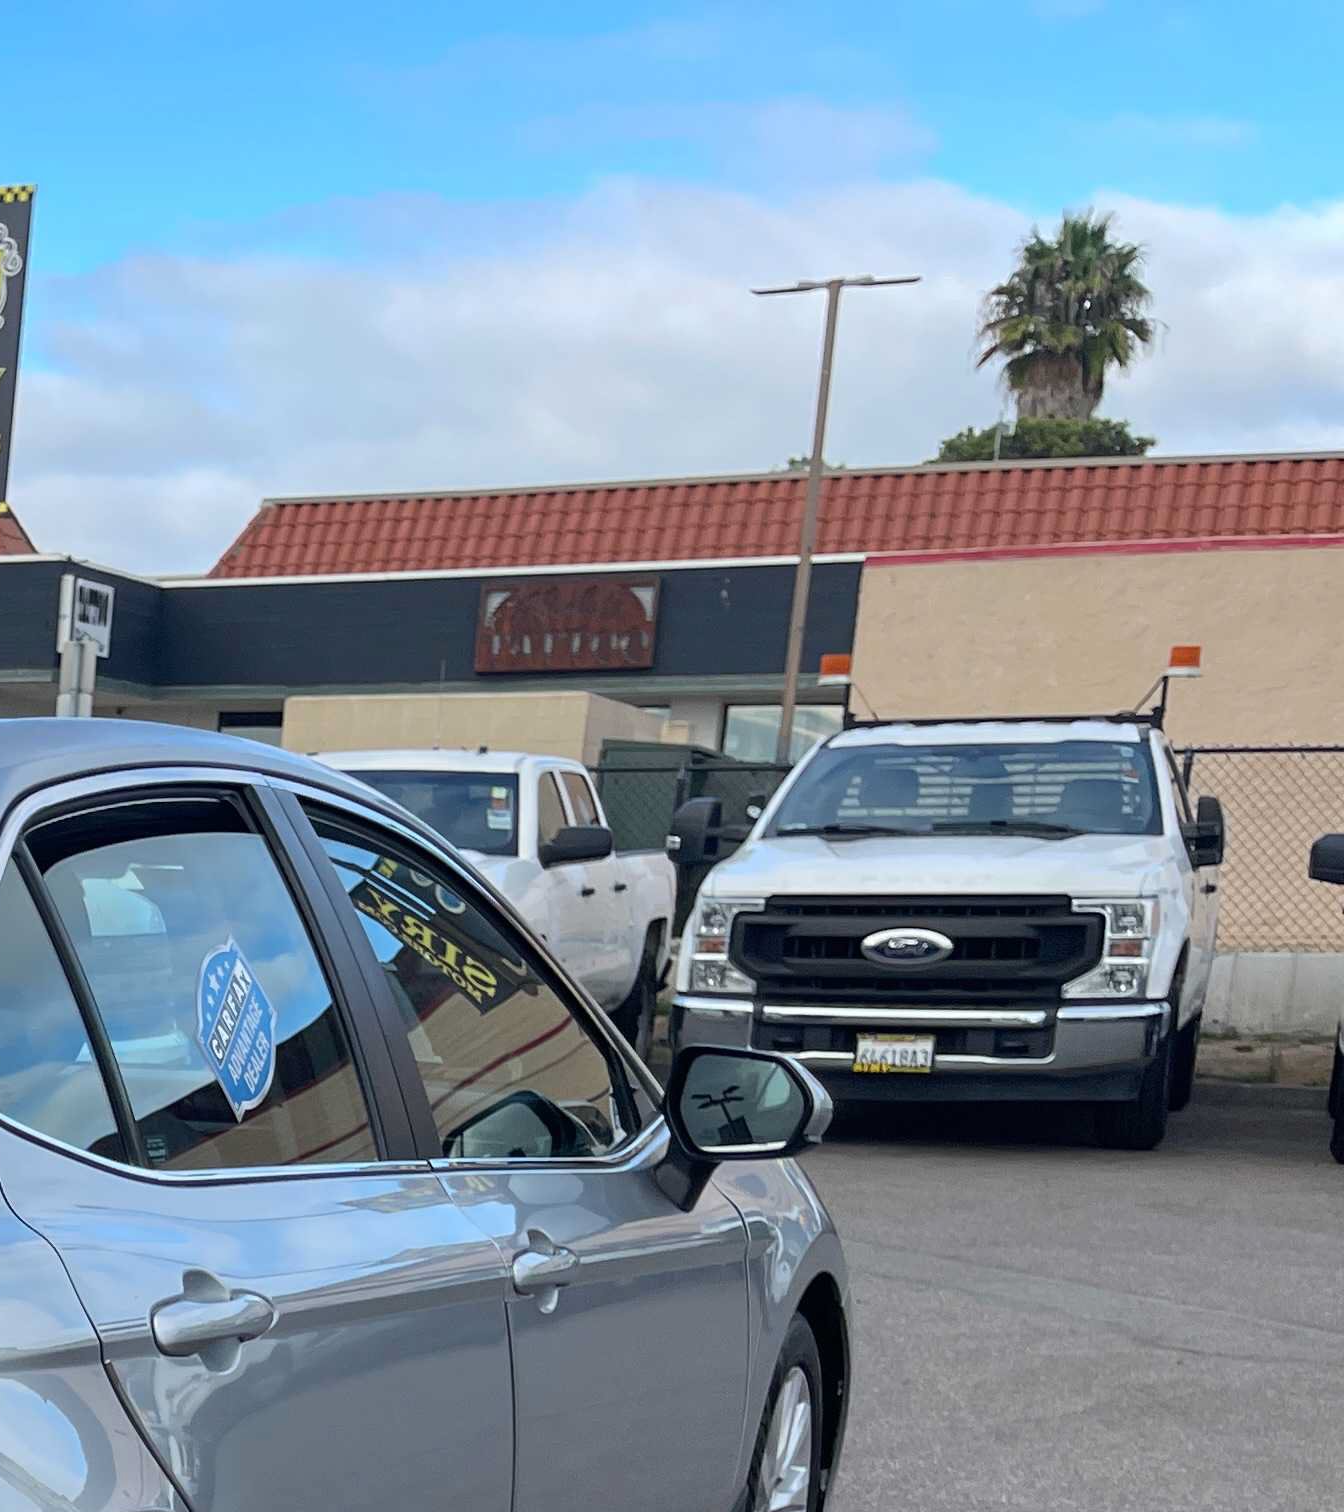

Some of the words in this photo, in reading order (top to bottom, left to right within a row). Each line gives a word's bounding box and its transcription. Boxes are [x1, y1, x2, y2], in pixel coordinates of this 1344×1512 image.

[211, 963, 252, 1060] CARFAX
[228, 995, 263, 1086] ADVANTAGE
[243, 1031, 270, 1095] DEALER
